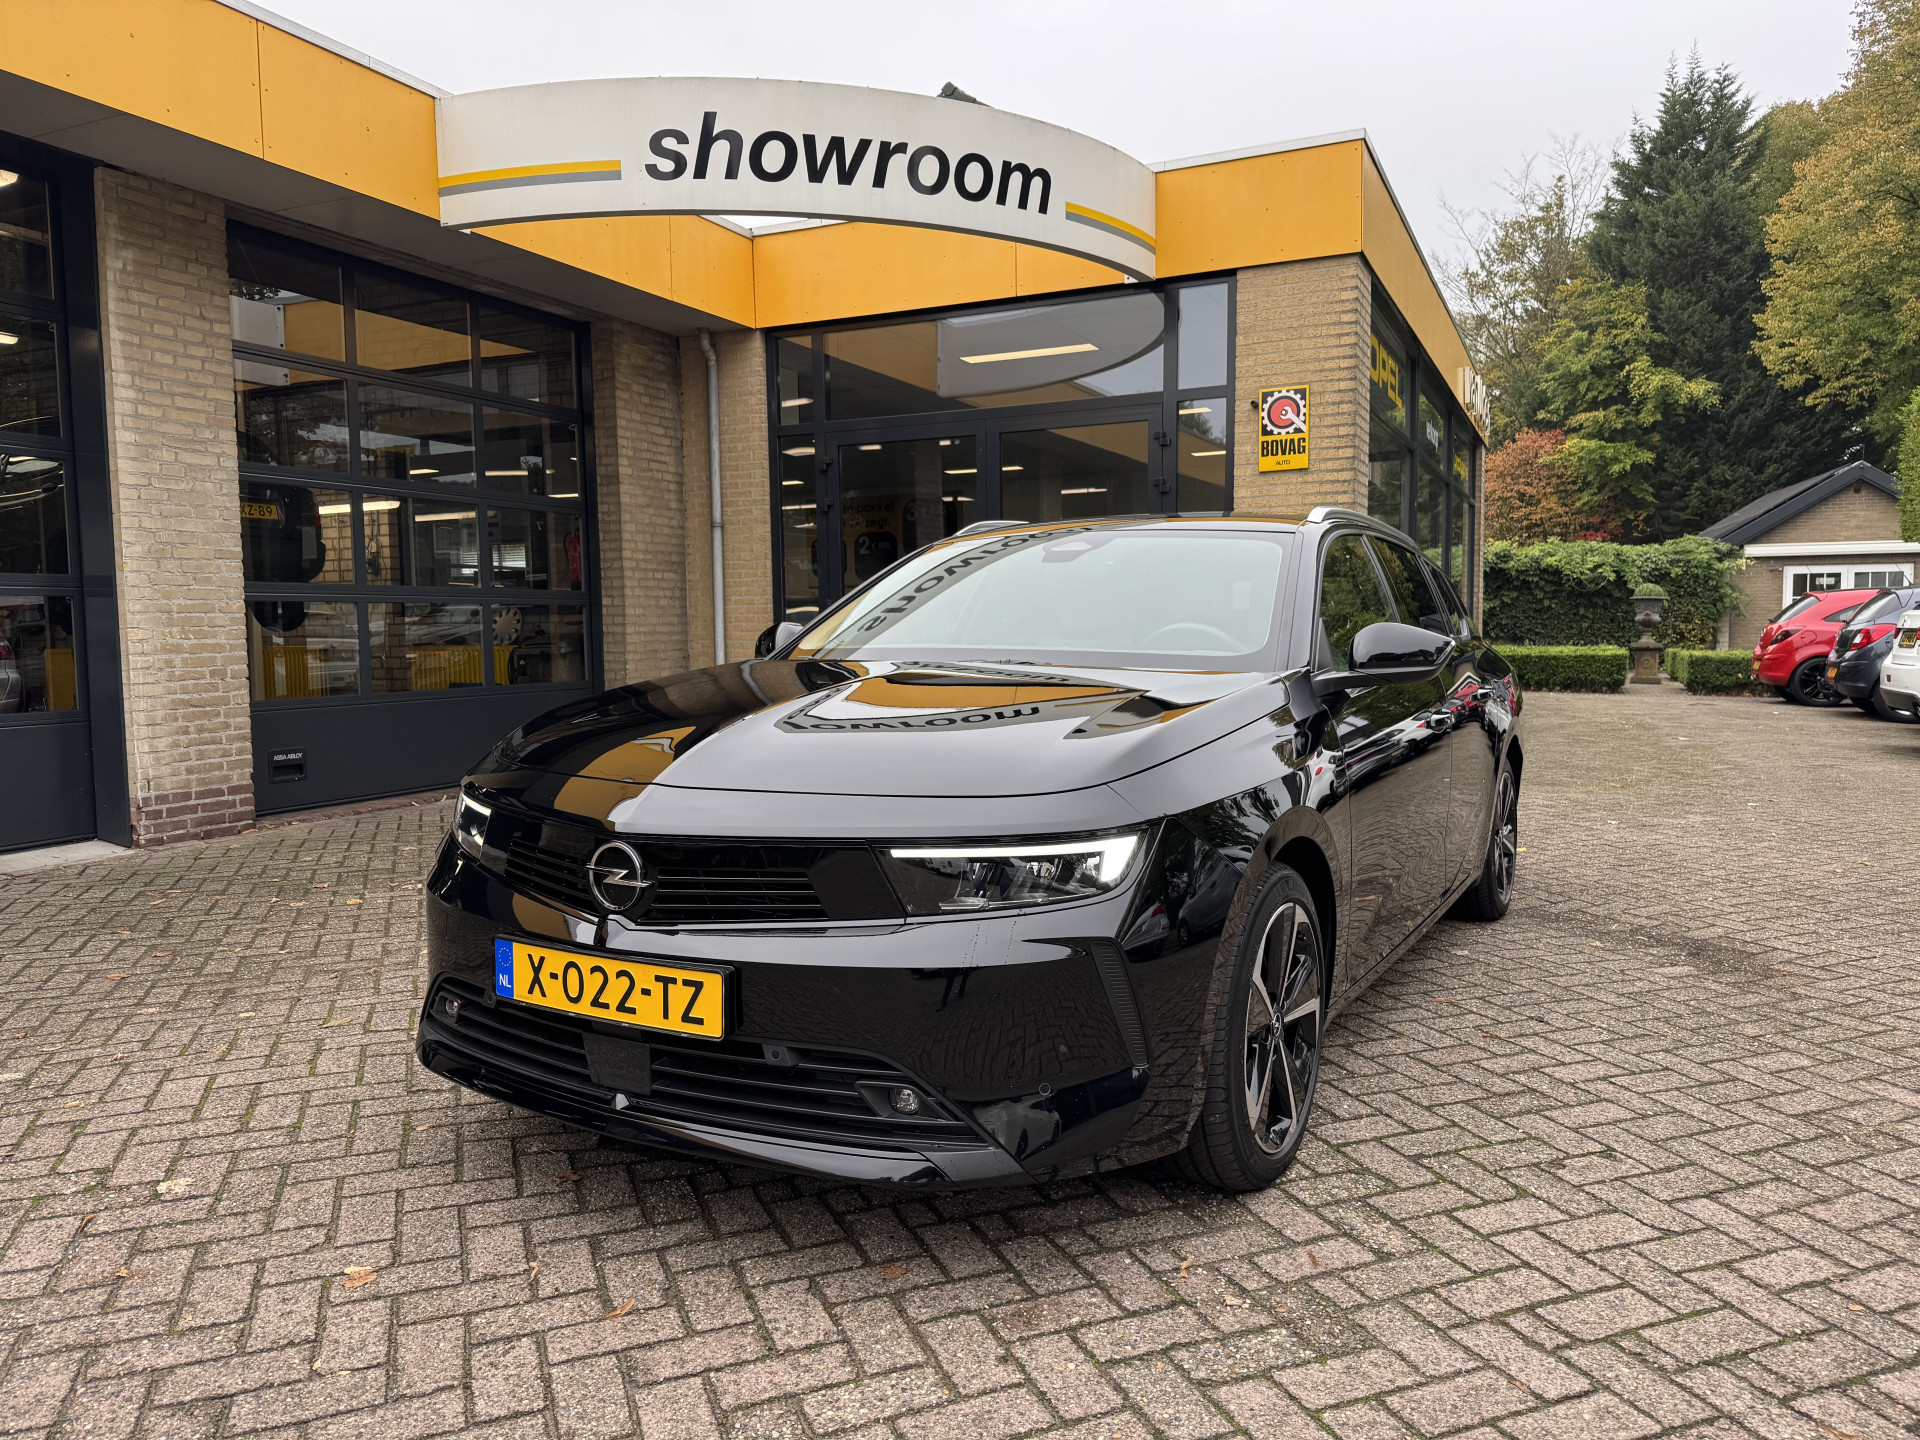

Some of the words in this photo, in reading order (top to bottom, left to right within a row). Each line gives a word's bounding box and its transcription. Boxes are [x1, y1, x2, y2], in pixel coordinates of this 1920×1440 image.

[644, 111, 1052, 215] showroom
[1370, 332, 1402, 408] OPEL
[1261, 437, 1306, 457] BOVAG
[499, 973, 512, 988] NL
[527, 953, 705, 1026] X-022-TZ
